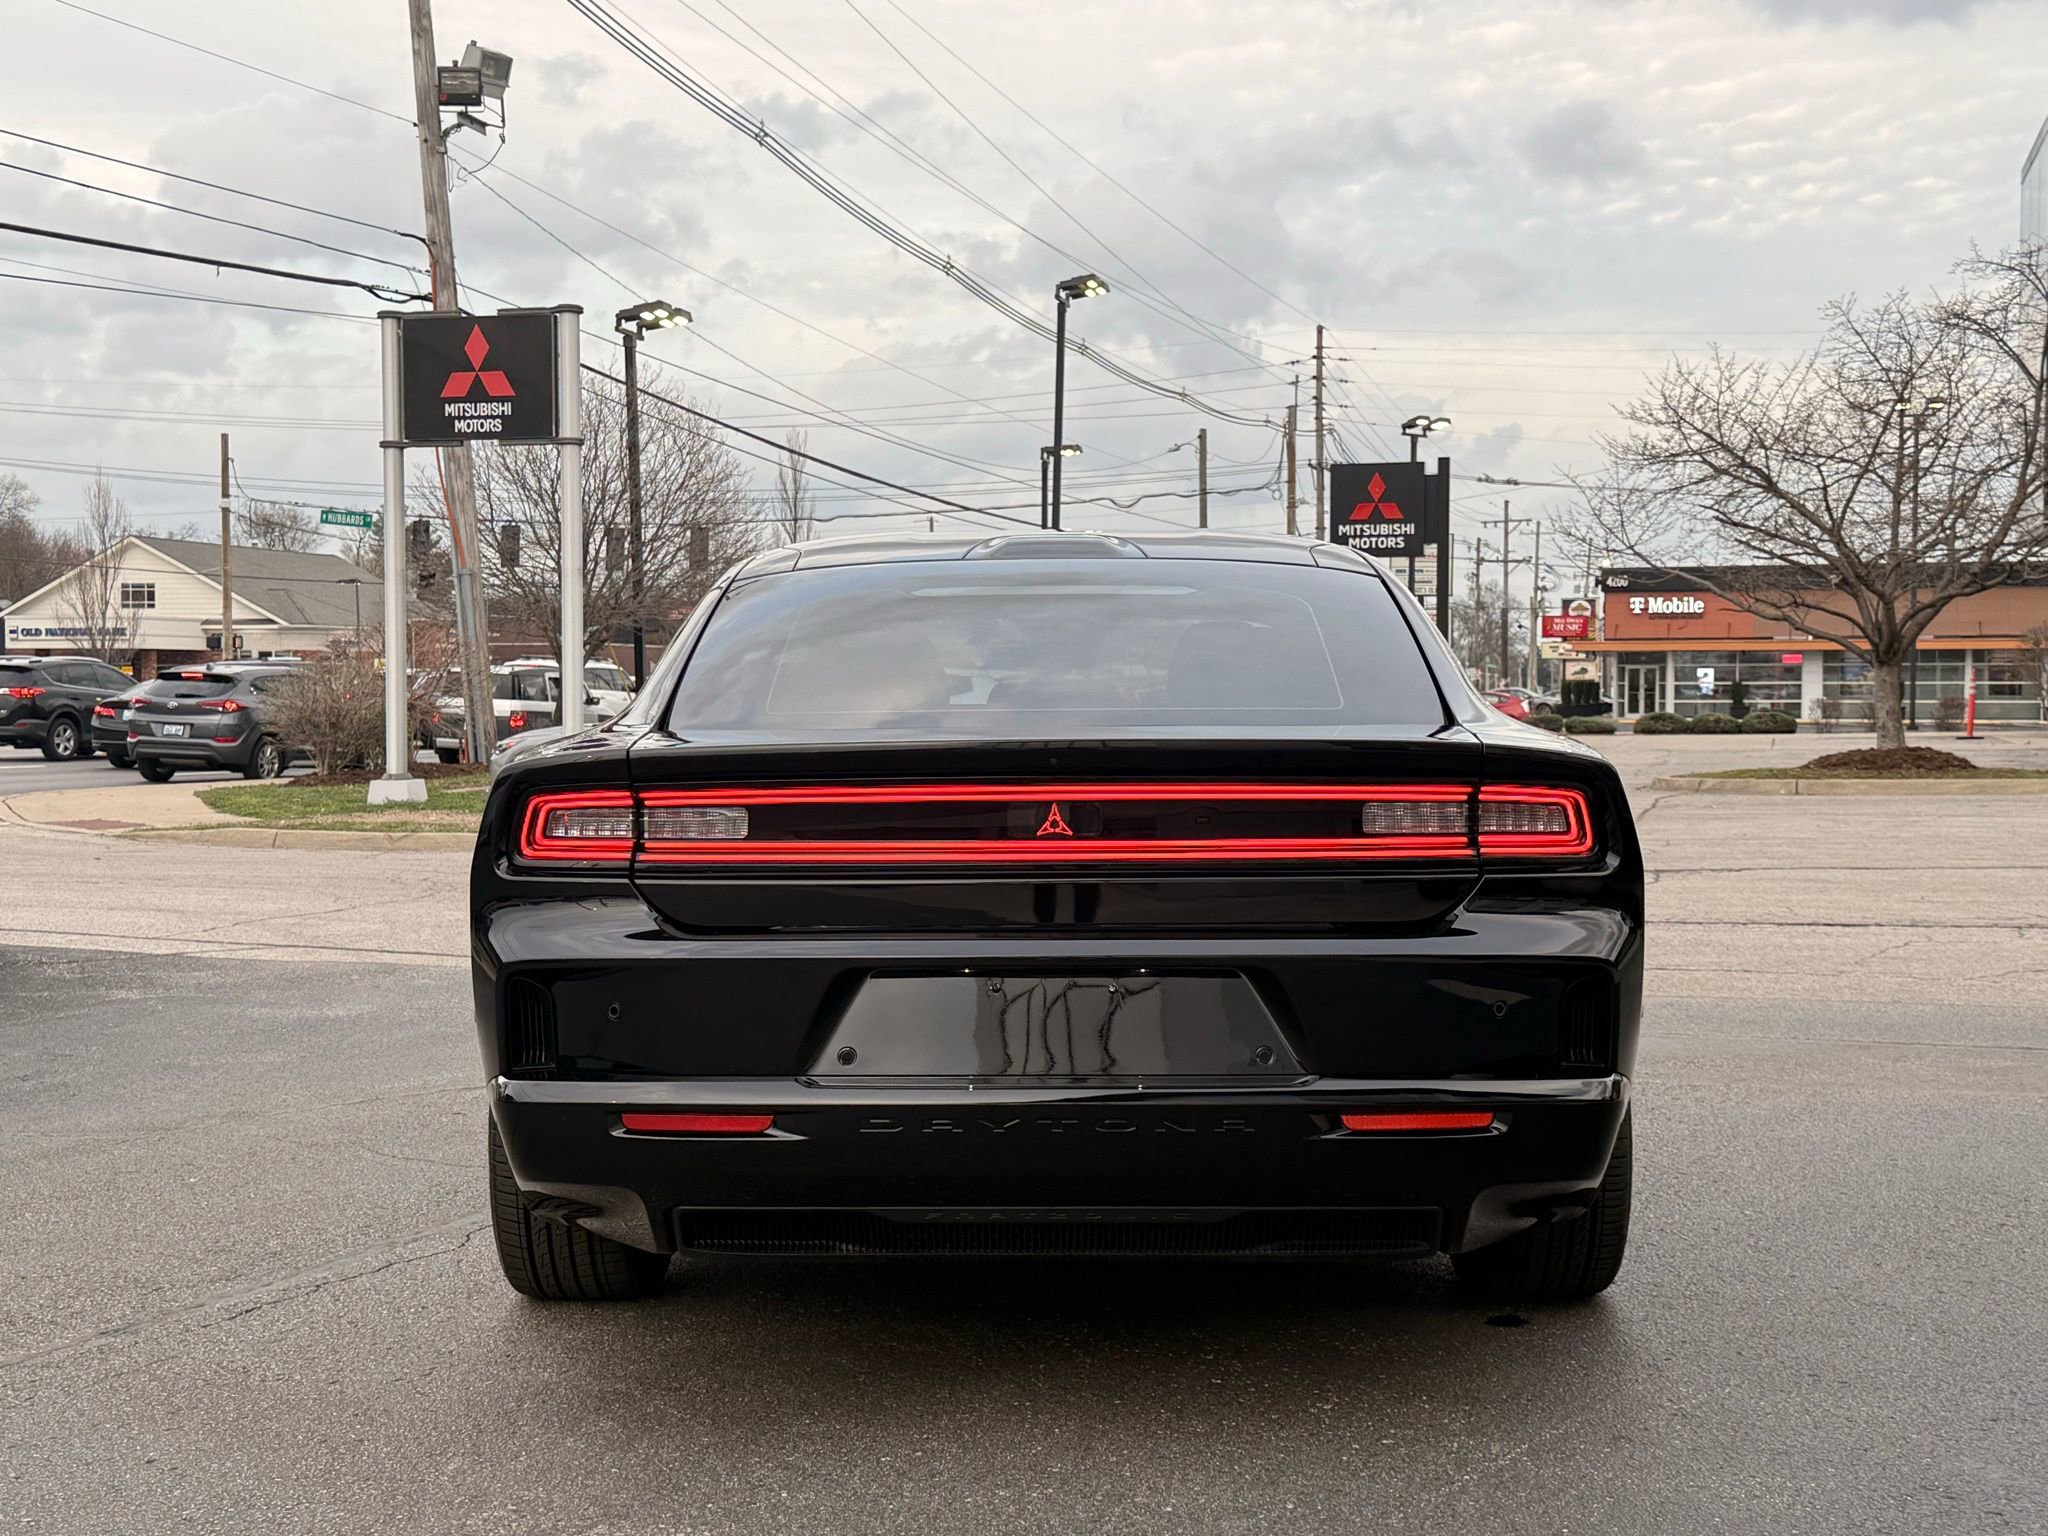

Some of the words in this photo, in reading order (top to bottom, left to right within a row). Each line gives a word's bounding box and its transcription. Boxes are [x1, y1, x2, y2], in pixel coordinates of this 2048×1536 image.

[444, 402, 512, 417] MITSUBISHI
[454, 419, 502, 433] MOTORS
[327, 512, 364, 525] HUBBARDS
[1338, 523, 1415, 536] MITSUBISHI
[1348, 537, 1405, 549] MOTORS
[1647, 596, 1705, 614] Mobile
[858, 1118, 1256, 1134] DAYTONA
